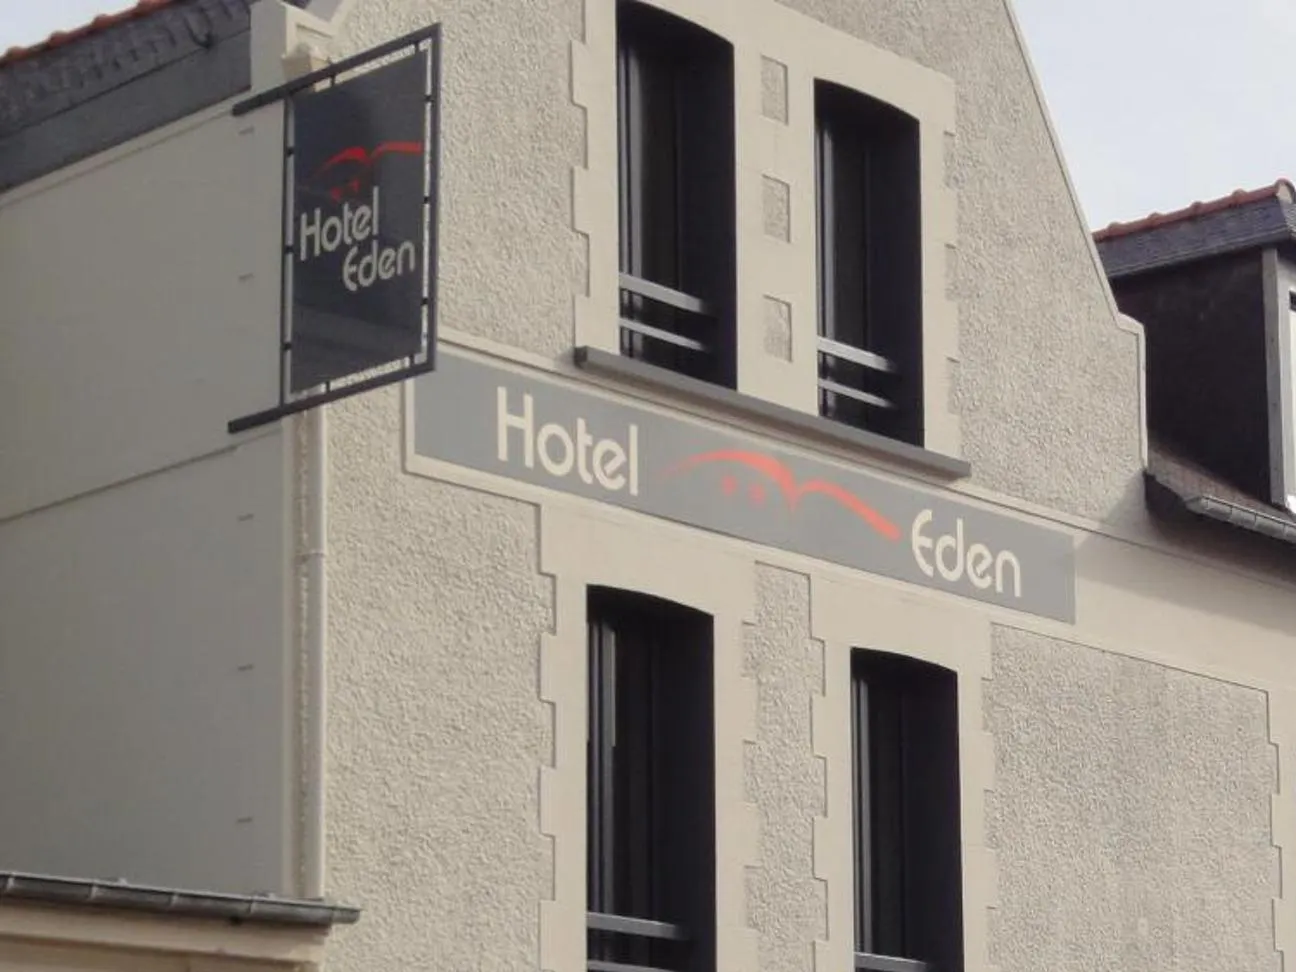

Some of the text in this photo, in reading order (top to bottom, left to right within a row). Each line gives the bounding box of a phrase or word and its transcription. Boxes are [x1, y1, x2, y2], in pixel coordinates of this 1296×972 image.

[301, 186, 379, 261] Hotel
[343, 240, 415, 291] Eden
[497, 386, 1022, 598] Hotel Eden
